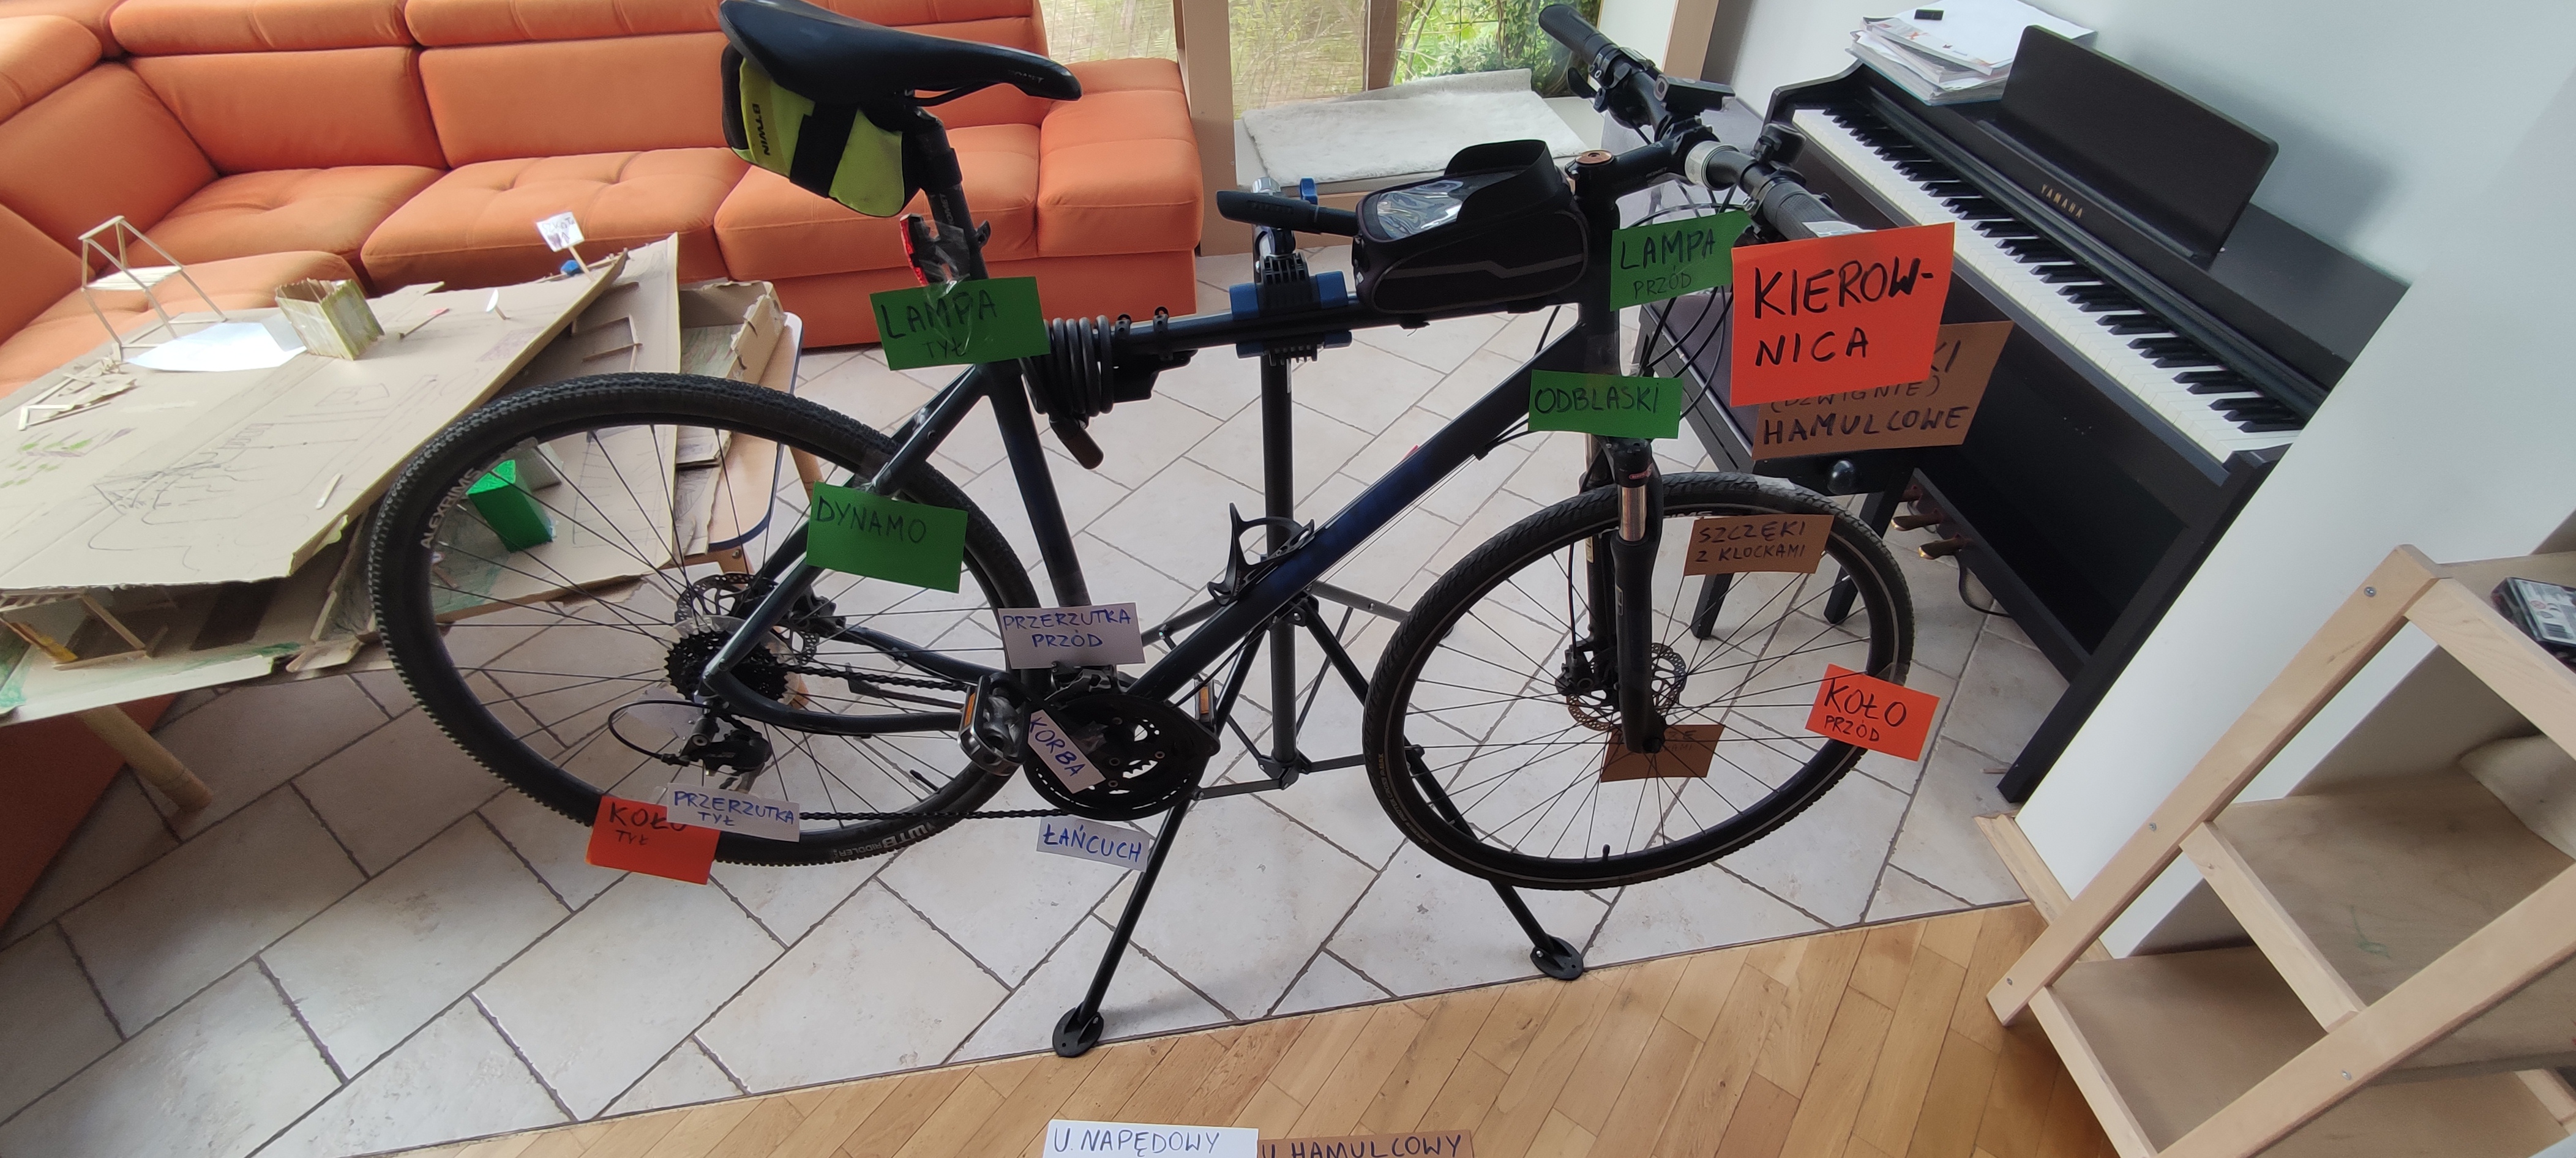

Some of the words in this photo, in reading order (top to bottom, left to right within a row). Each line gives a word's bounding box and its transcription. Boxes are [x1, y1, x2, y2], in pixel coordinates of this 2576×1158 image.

[752, 103, 771, 156] BTWIN
[2040, 184, 2083, 219] YAMAHA
[1620, 228, 1716, 270] LAMPA
[1633, 264, 1692, 300] PRZÓD
[1754, 255, 1934, 319] KIEROW-
[880, 289, 998, 339] LAMPA
[922, 337, 967, 359] TYŁ
[1754, 326, 1869, 367] NICA
[1534, 382, 1660, 414] ODBLASKI
[1763, 406, 1970, 446] HAMULCOWE
[421, 467, 484, 549] ALEXRIMS
[817, 495, 927, 544] DYNAMO
[1698, 521, 1806, 544] SZCZĘKI
[1695, 550, 1709, 562] Z
[1718, 543, 1806, 561] KLOCKAMI
[1002, 608, 1131, 631] PRZERZUTKA
[1031, 629, 1104, 648] PRZÓD
[1824, 678, 1908, 727] KOŁO
[1824, 714, 1880, 742] PRZÓD
[1029, 716, 1087, 777] KORBA
[673, 790, 795, 825] PRZERZUTKA
[697, 811, 735, 826] TYŁ
[615, 829, 650, 846] TYŁ
[838, 842, 883, 857] RIDDLER
[882, 824, 929, 849] WTB
[1043, 823, 1143, 863] ŁAŃCUCH
[1054, 1127, 1074, 1153] U.
[1080, 1129, 1220, 1157] NAPĘDOWY
[1290, 1134, 1461, 1158] HAMULCOWY
